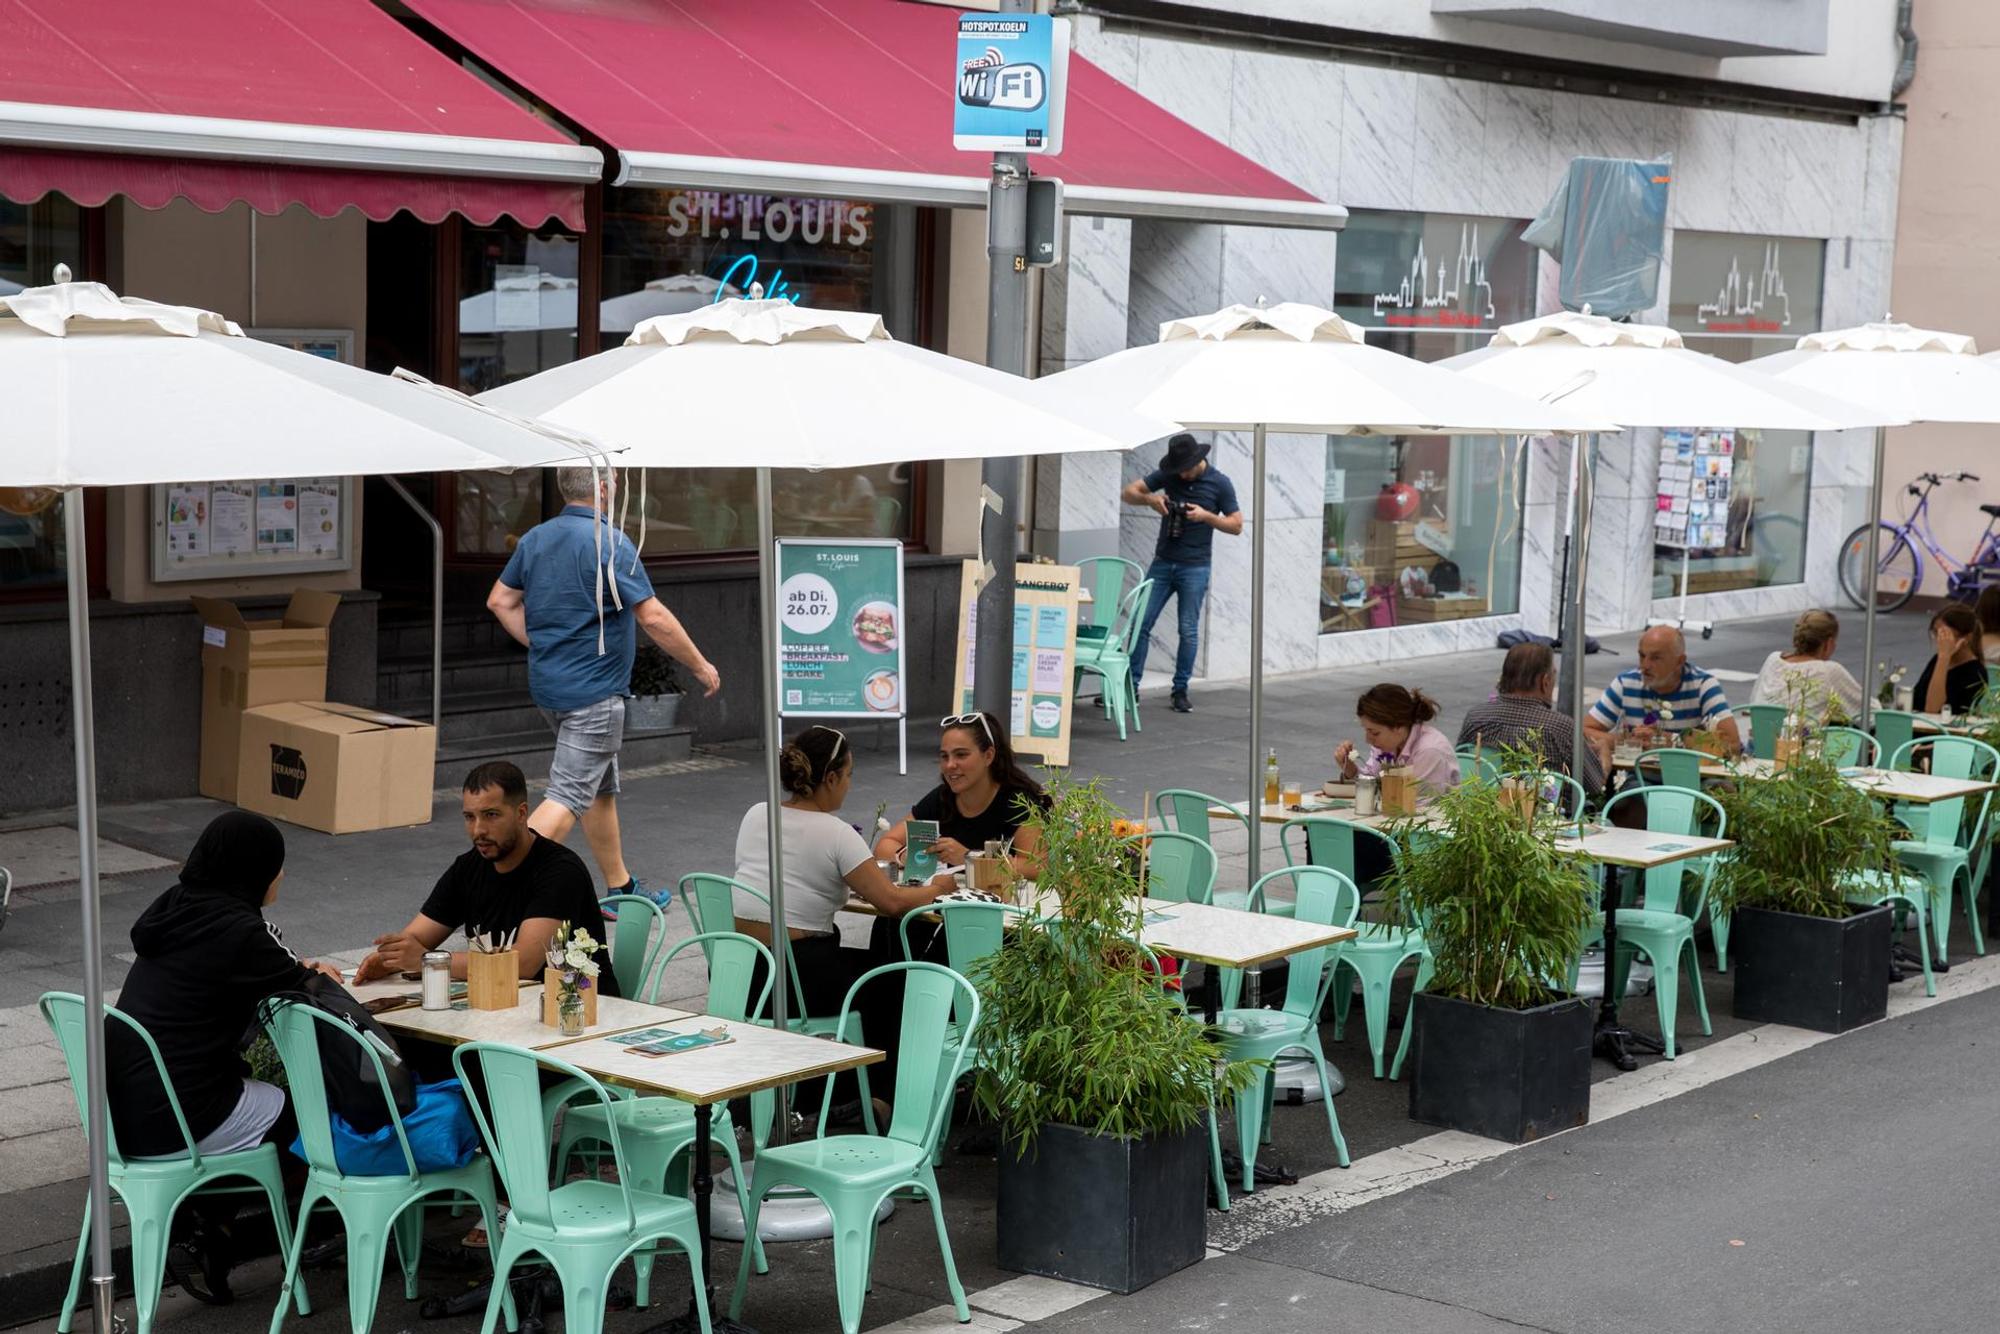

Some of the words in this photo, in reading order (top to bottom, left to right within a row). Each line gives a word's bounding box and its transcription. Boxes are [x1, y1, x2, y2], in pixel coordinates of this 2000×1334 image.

[961, 22, 1027, 32] HOTSPOT.KOELN
[963, 58, 985, 70] FREE
[1015, 579, 1071, 591] SANGEBOT
[789, 590, 806, 602] ab
[810, 590, 828, 602] Di.
[787, 604, 831, 616] 26.07.
[787, 661, 821, 669] LUNCH
[796, 670, 823, 678] CAKE
